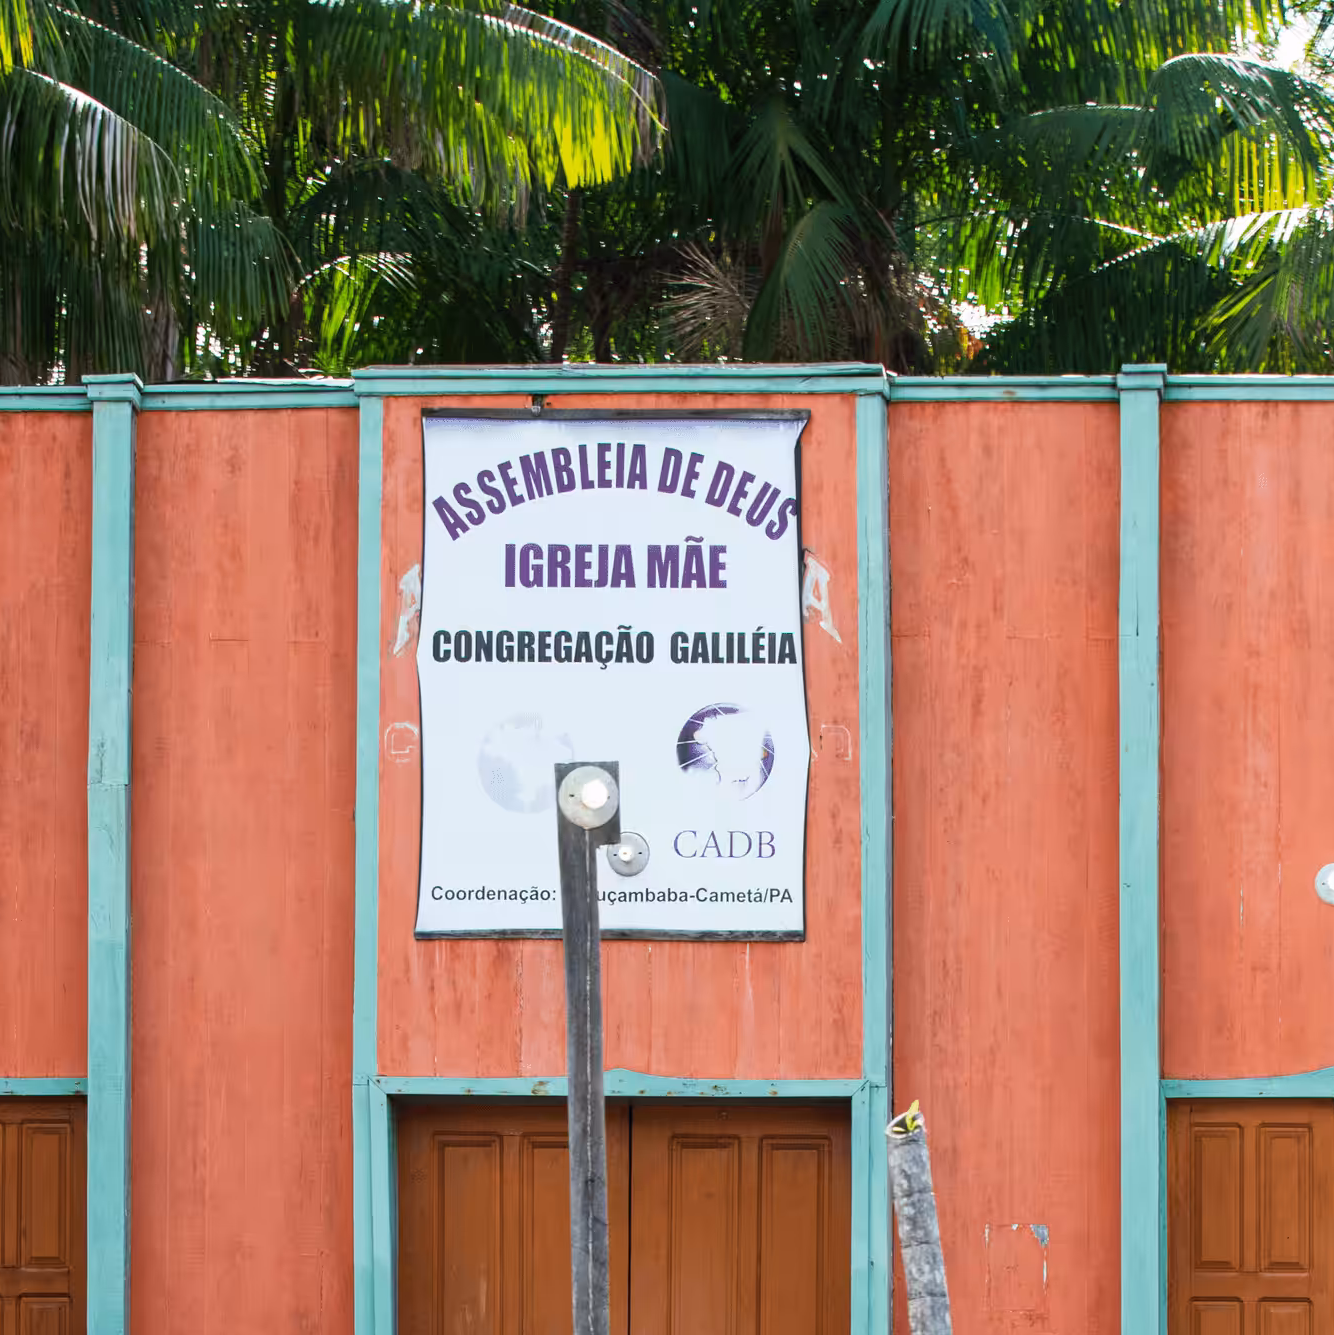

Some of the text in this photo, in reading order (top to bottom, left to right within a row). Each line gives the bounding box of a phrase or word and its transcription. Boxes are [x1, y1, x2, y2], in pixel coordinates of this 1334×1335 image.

[432, 442, 797, 541] ASSEMBLEIA DE DEUS
[504, 535, 728, 589] IGREJA MÃE
[432, 625, 798, 670] CONGREGAÇÃO GALILÉIA
[673, 830, 776, 859] CADB
[431, 885, 793, 905] Coordenação: uçambaba-Cametá/PA
